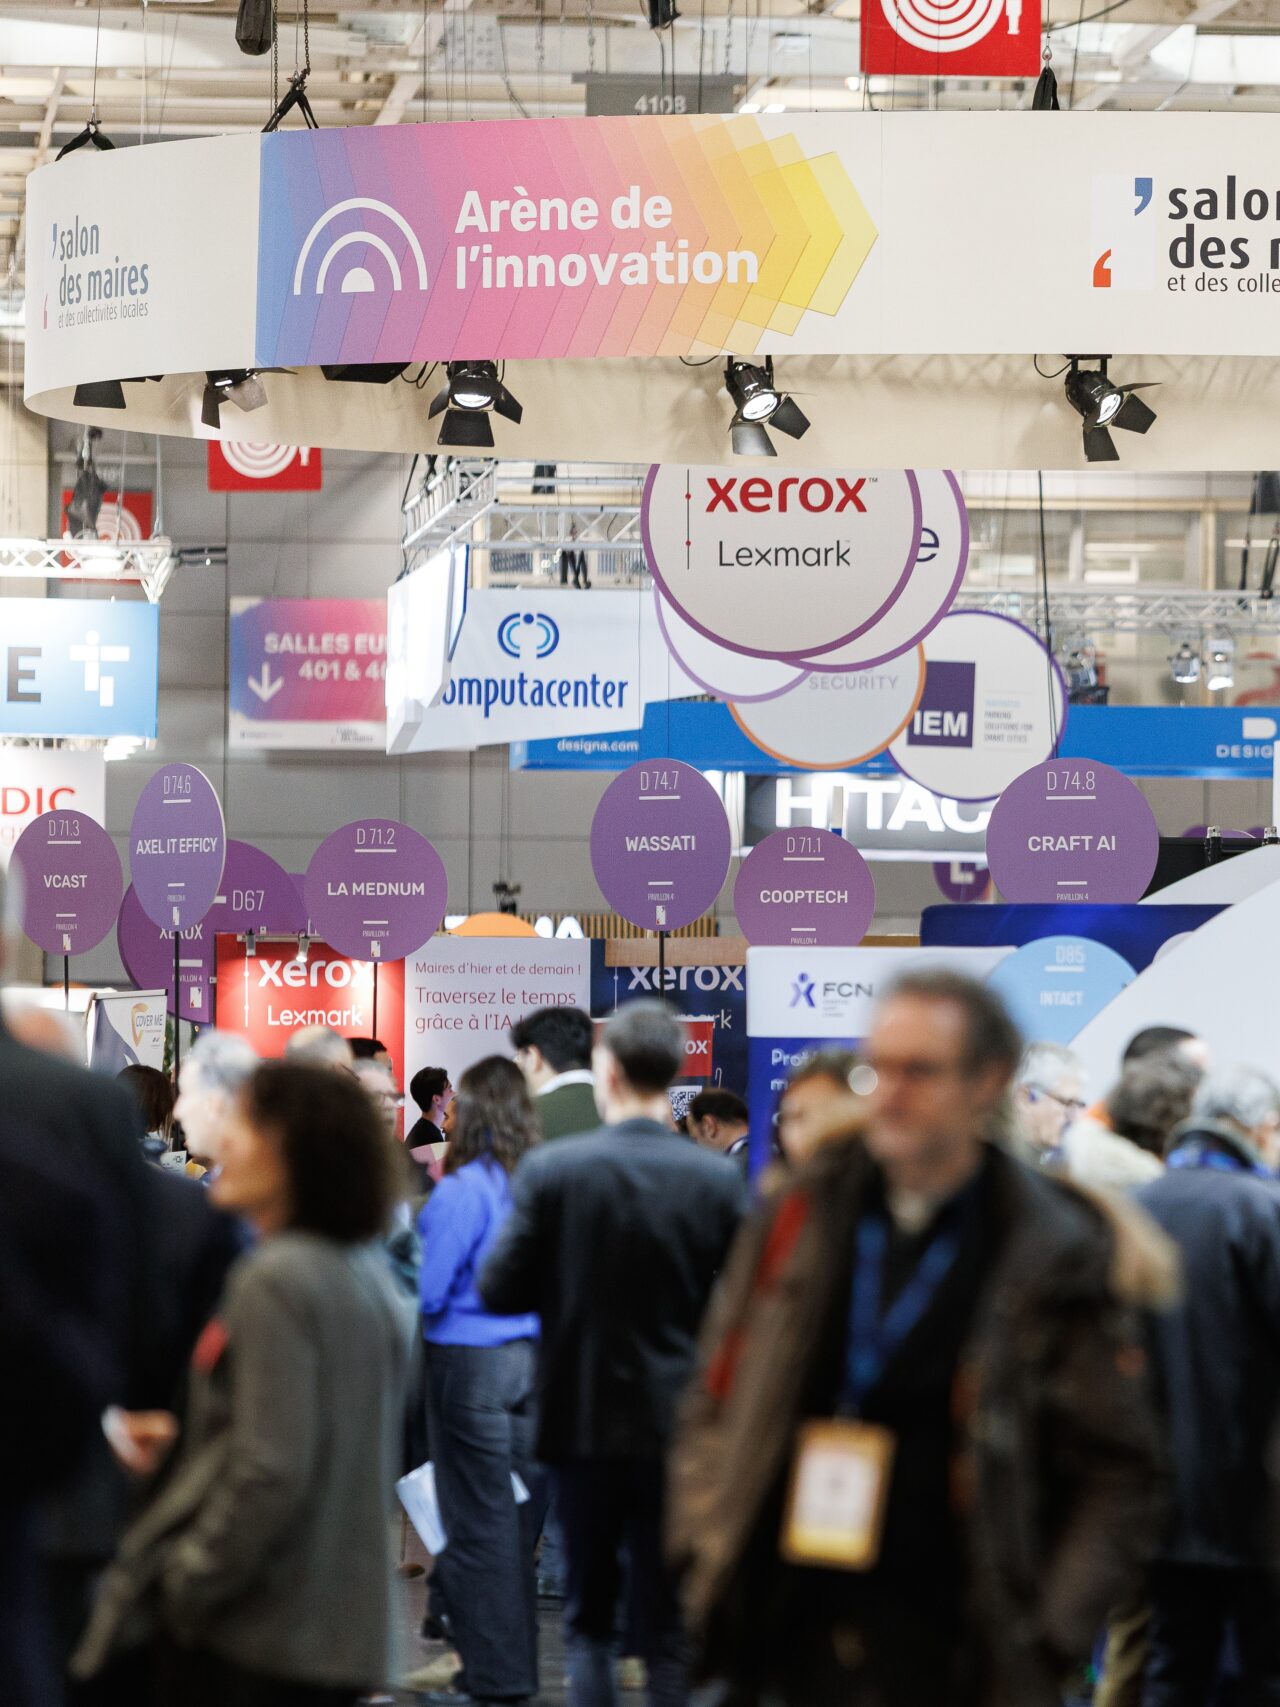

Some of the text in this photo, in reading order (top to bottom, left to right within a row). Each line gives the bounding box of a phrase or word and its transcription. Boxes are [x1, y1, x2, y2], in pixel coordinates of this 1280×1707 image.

[455, 185, 673, 234] Arène de
[60, 215, 99, 261] salon
[1169, 223, 1250, 270] des
[456, 239, 758, 290] l'innovation
[59, 255, 149, 306] des maires
[1167, 273, 1187, 292] et
[1195, 272, 1228, 293] des
[120, 298, 149, 319] locales
[705, 477, 867, 513] xerox
[718, 540, 850, 567] Lexmark
[264, 632, 387, 655] SALLES EU
[7, 647, 42, 702] E
[298, 659, 340, 681] 401
[344, 659, 361, 681] &
[809, 675, 899, 690] SECURITY
[442, 672, 628, 718] omputacenter
[912, 710, 968, 737] IEM
[557, 737, 639, 754] designa.com
[1216, 744, 1274, 760] DESIG
[163, 775, 191, 794] D 74.6
[640, 771, 679, 791] D 74.7
[1047, 770, 1095, 791] D 74.8
[49, 819, 80, 837] D 71.3
[356, 828, 395, 845] D 71.2
[136, 837, 218, 854] AXEL IT EFFICY
[625, 835, 696, 852] WASSATI
[787, 837, 821, 853] D 71.1
[1028, 835, 1116, 851] CRAFT AI
[43, 874, 88, 889] VCAST
[327, 882, 425, 896] LA MEDNUM
[232, 890, 265, 912] D67
[760, 889, 848, 904] COOPTECH
[1056, 893, 1083, 901] PAVILLON
[362, 930, 385, 938] PAVILLON
[790, 937, 813, 945] PAVILLON
[172, 974, 198, 983] PVILLON
[258, 958, 375, 989] xerox
[415, 962, 455, 974] Maires
[458, 962, 492, 974] d'hier
[495, 964, 507, 975] et
[510, 964, 526, 975] de
[529, 964, 574, 975] demain
[628, 966, 744, 991] xerox
[415, 986, 576, 1007] Traversez le temps
[822, 982, 873, 998] FCN
[1040, 991, 1083, 1006] INTACT
[136, 1014, 164, 1028] COVER ME
[267, 1004, 363, 1027] Lexmark
[415, 1014, 513, 1034] grâce à l'IA
